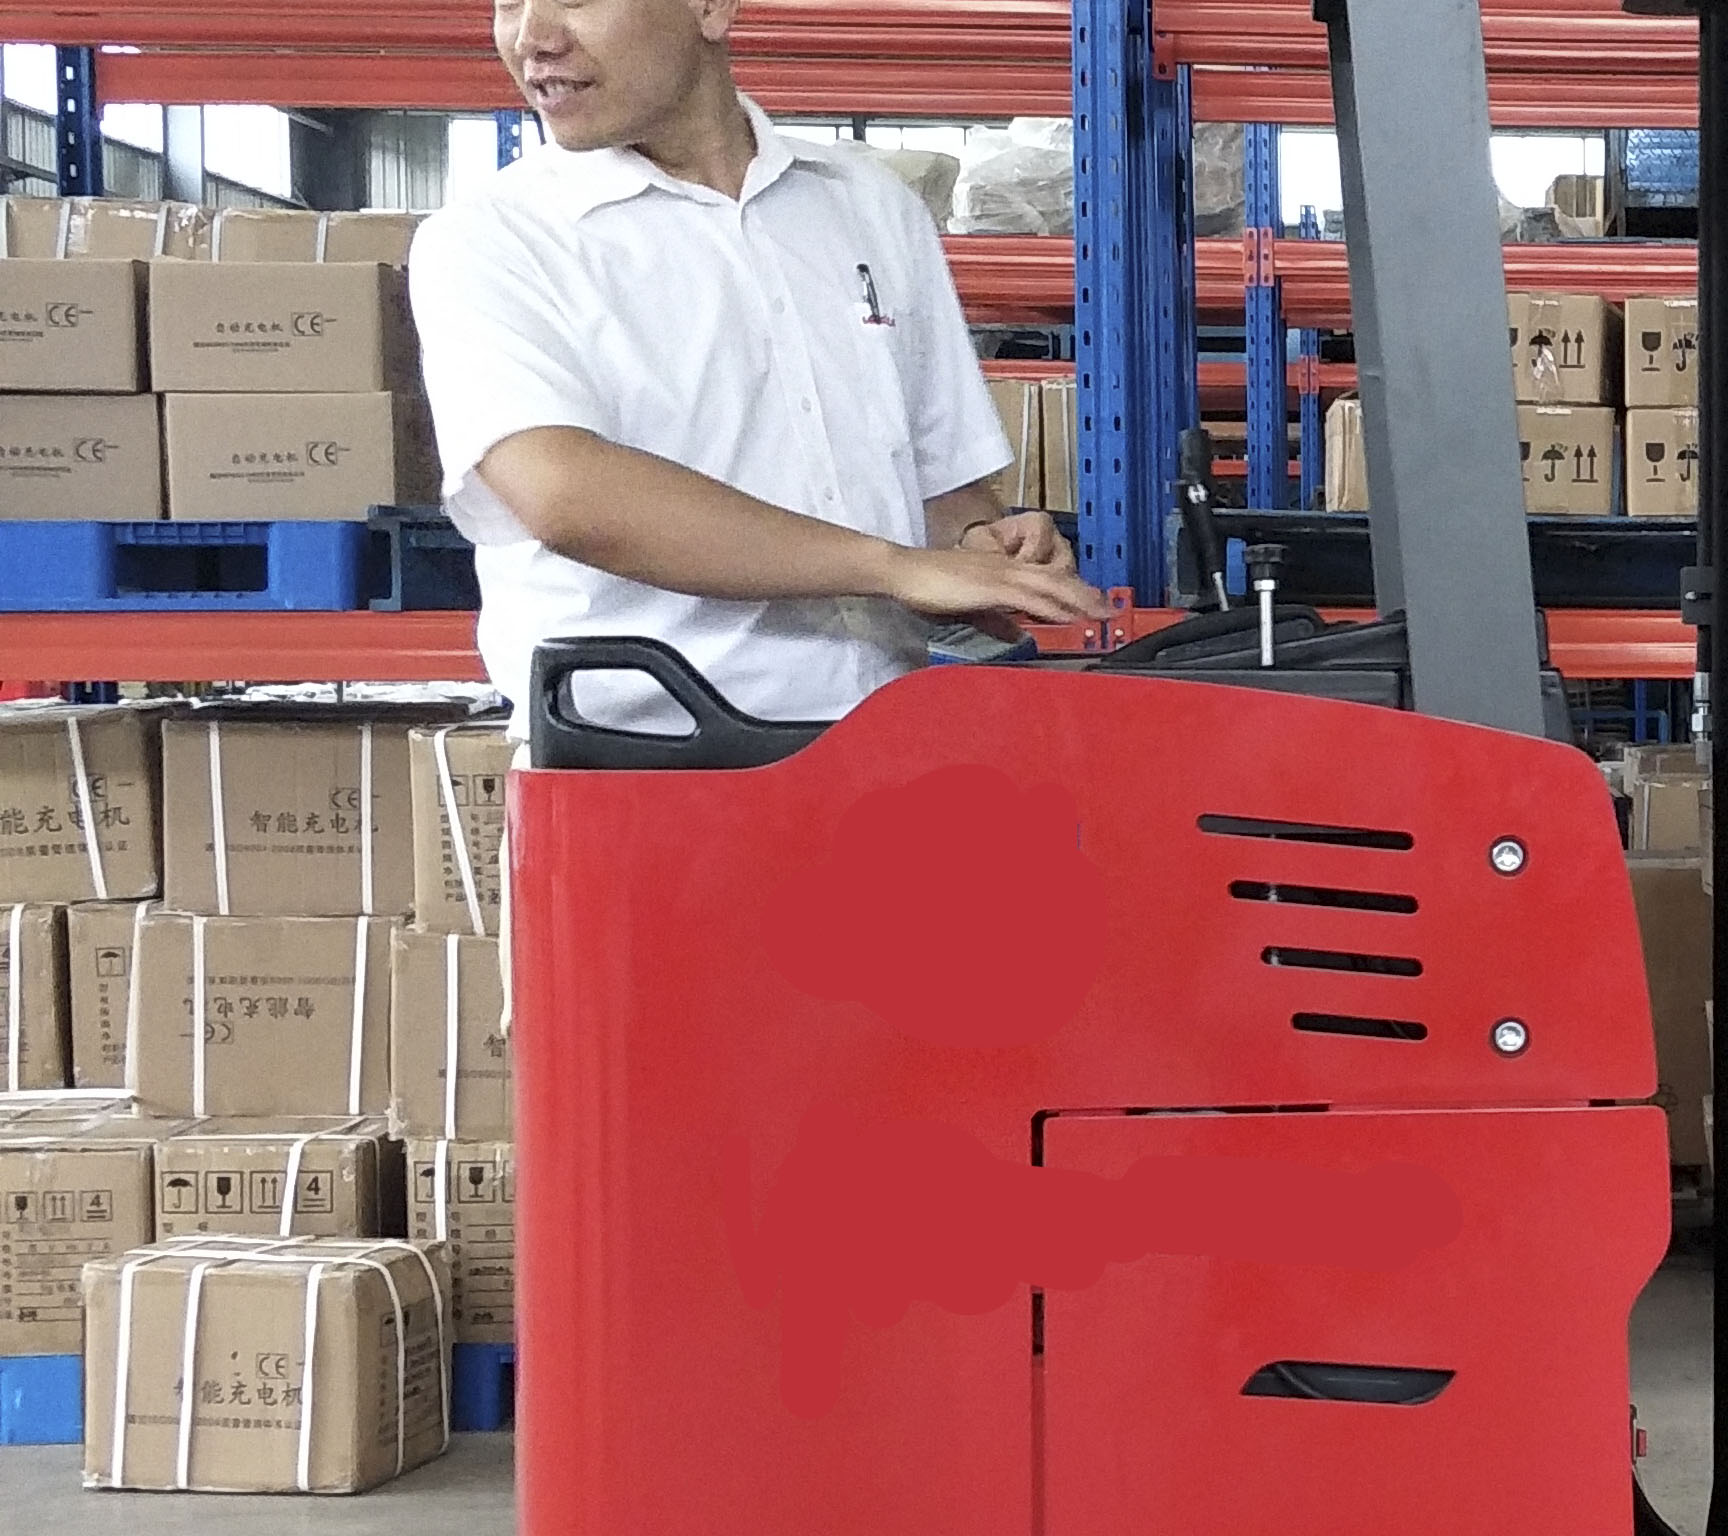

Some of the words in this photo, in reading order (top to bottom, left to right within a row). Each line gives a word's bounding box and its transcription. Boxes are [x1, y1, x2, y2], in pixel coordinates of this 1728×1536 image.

[49, 305, 77, 326] CE
[294, 314, 321, 336] CE
[75, 440, 104, 461] CE
[309, 443, 337, 465] CE
[306, 1175, 321, 1195] 4
[258, 1356, 286, 1377] CE
[173, 1377, 302, 1407] 能充电机
